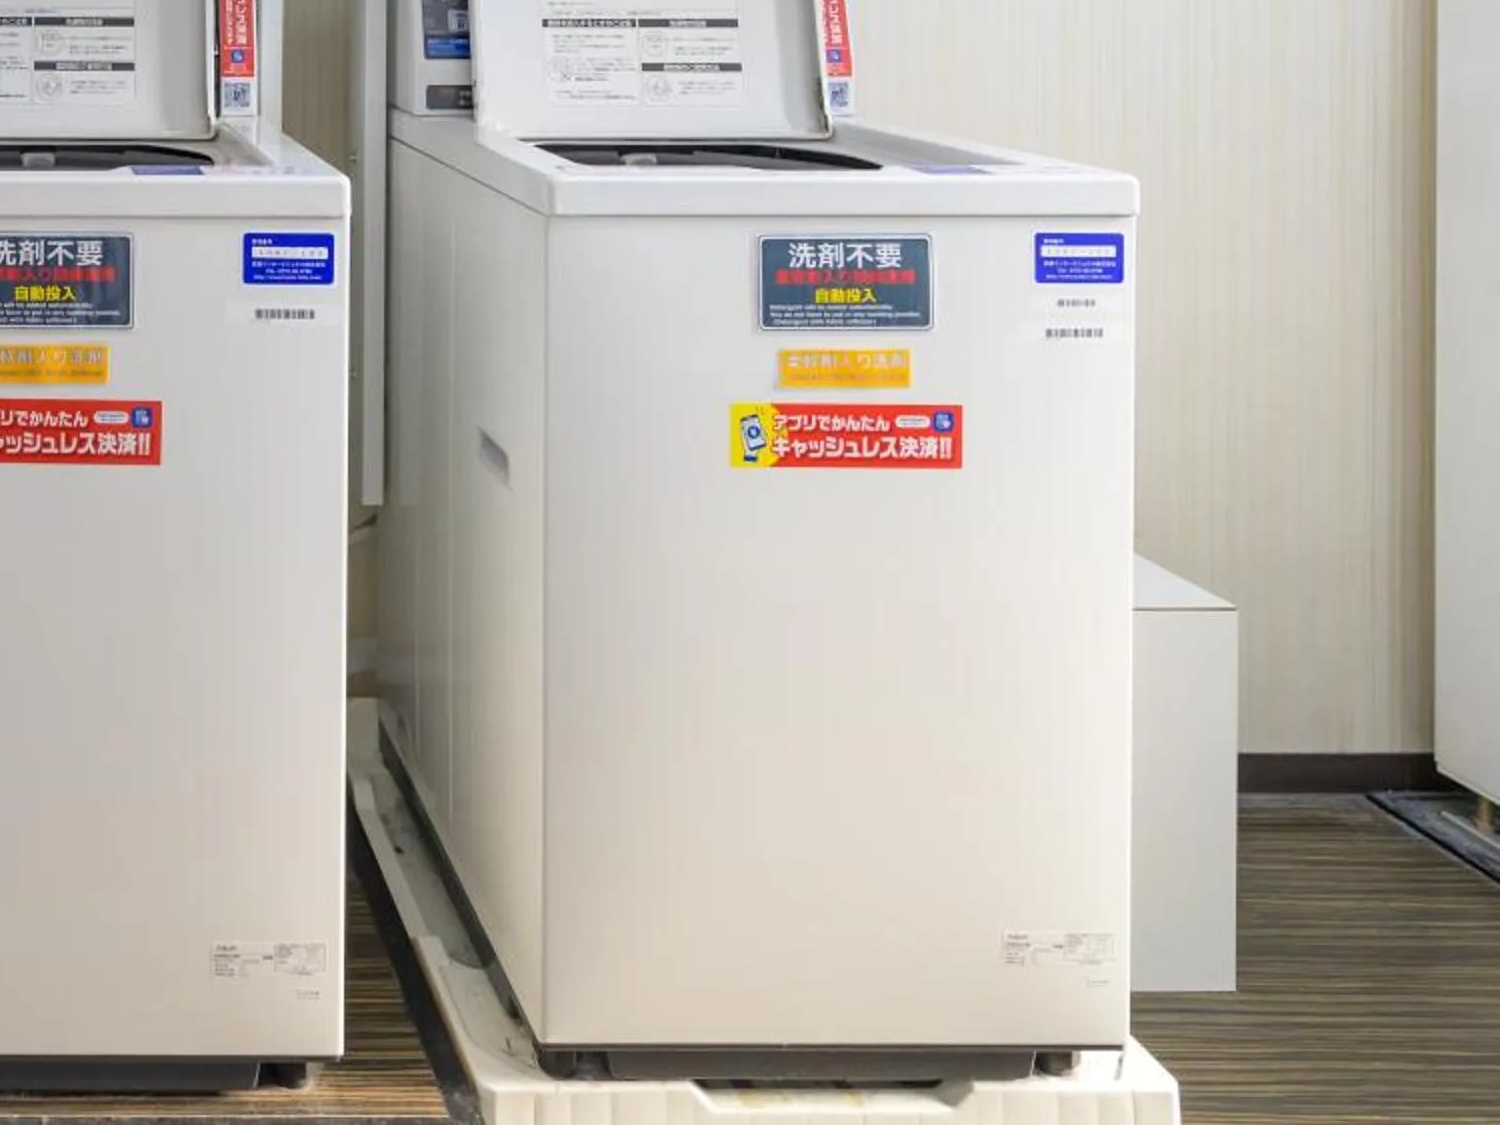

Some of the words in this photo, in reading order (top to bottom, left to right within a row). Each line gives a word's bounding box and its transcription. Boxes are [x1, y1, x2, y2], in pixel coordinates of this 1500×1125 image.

[788, 242, 902, 269] 洗剤不要
[14, 285, 76, 301] 自動投入
[814, 287, 876, 303] 自動投入
[772, 413, 891, 431] アプリでかんたん
